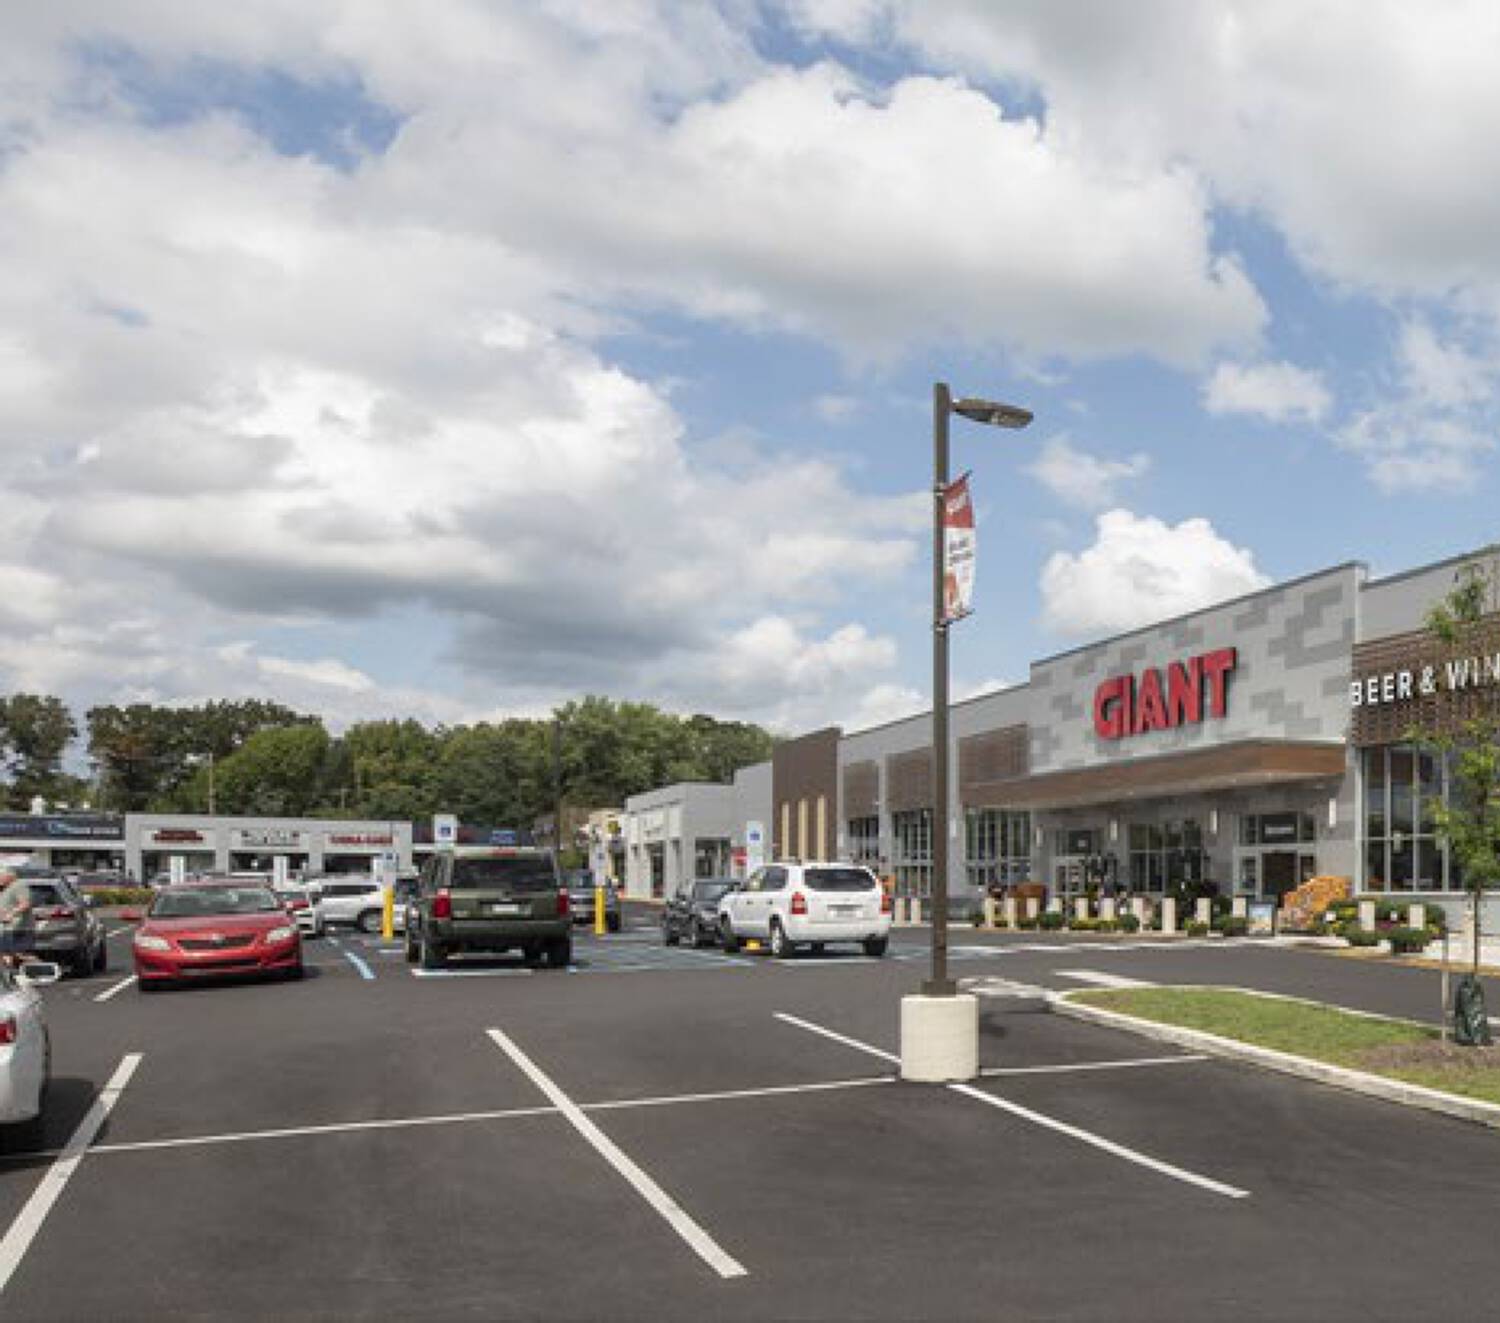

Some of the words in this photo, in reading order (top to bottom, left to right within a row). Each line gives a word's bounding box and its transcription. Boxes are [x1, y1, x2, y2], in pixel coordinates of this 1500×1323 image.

[1094, 647, 1237, 740] GIANT
[1351, 670, 1411, 706] BEER
[1420, 665, 1436, 694] &
